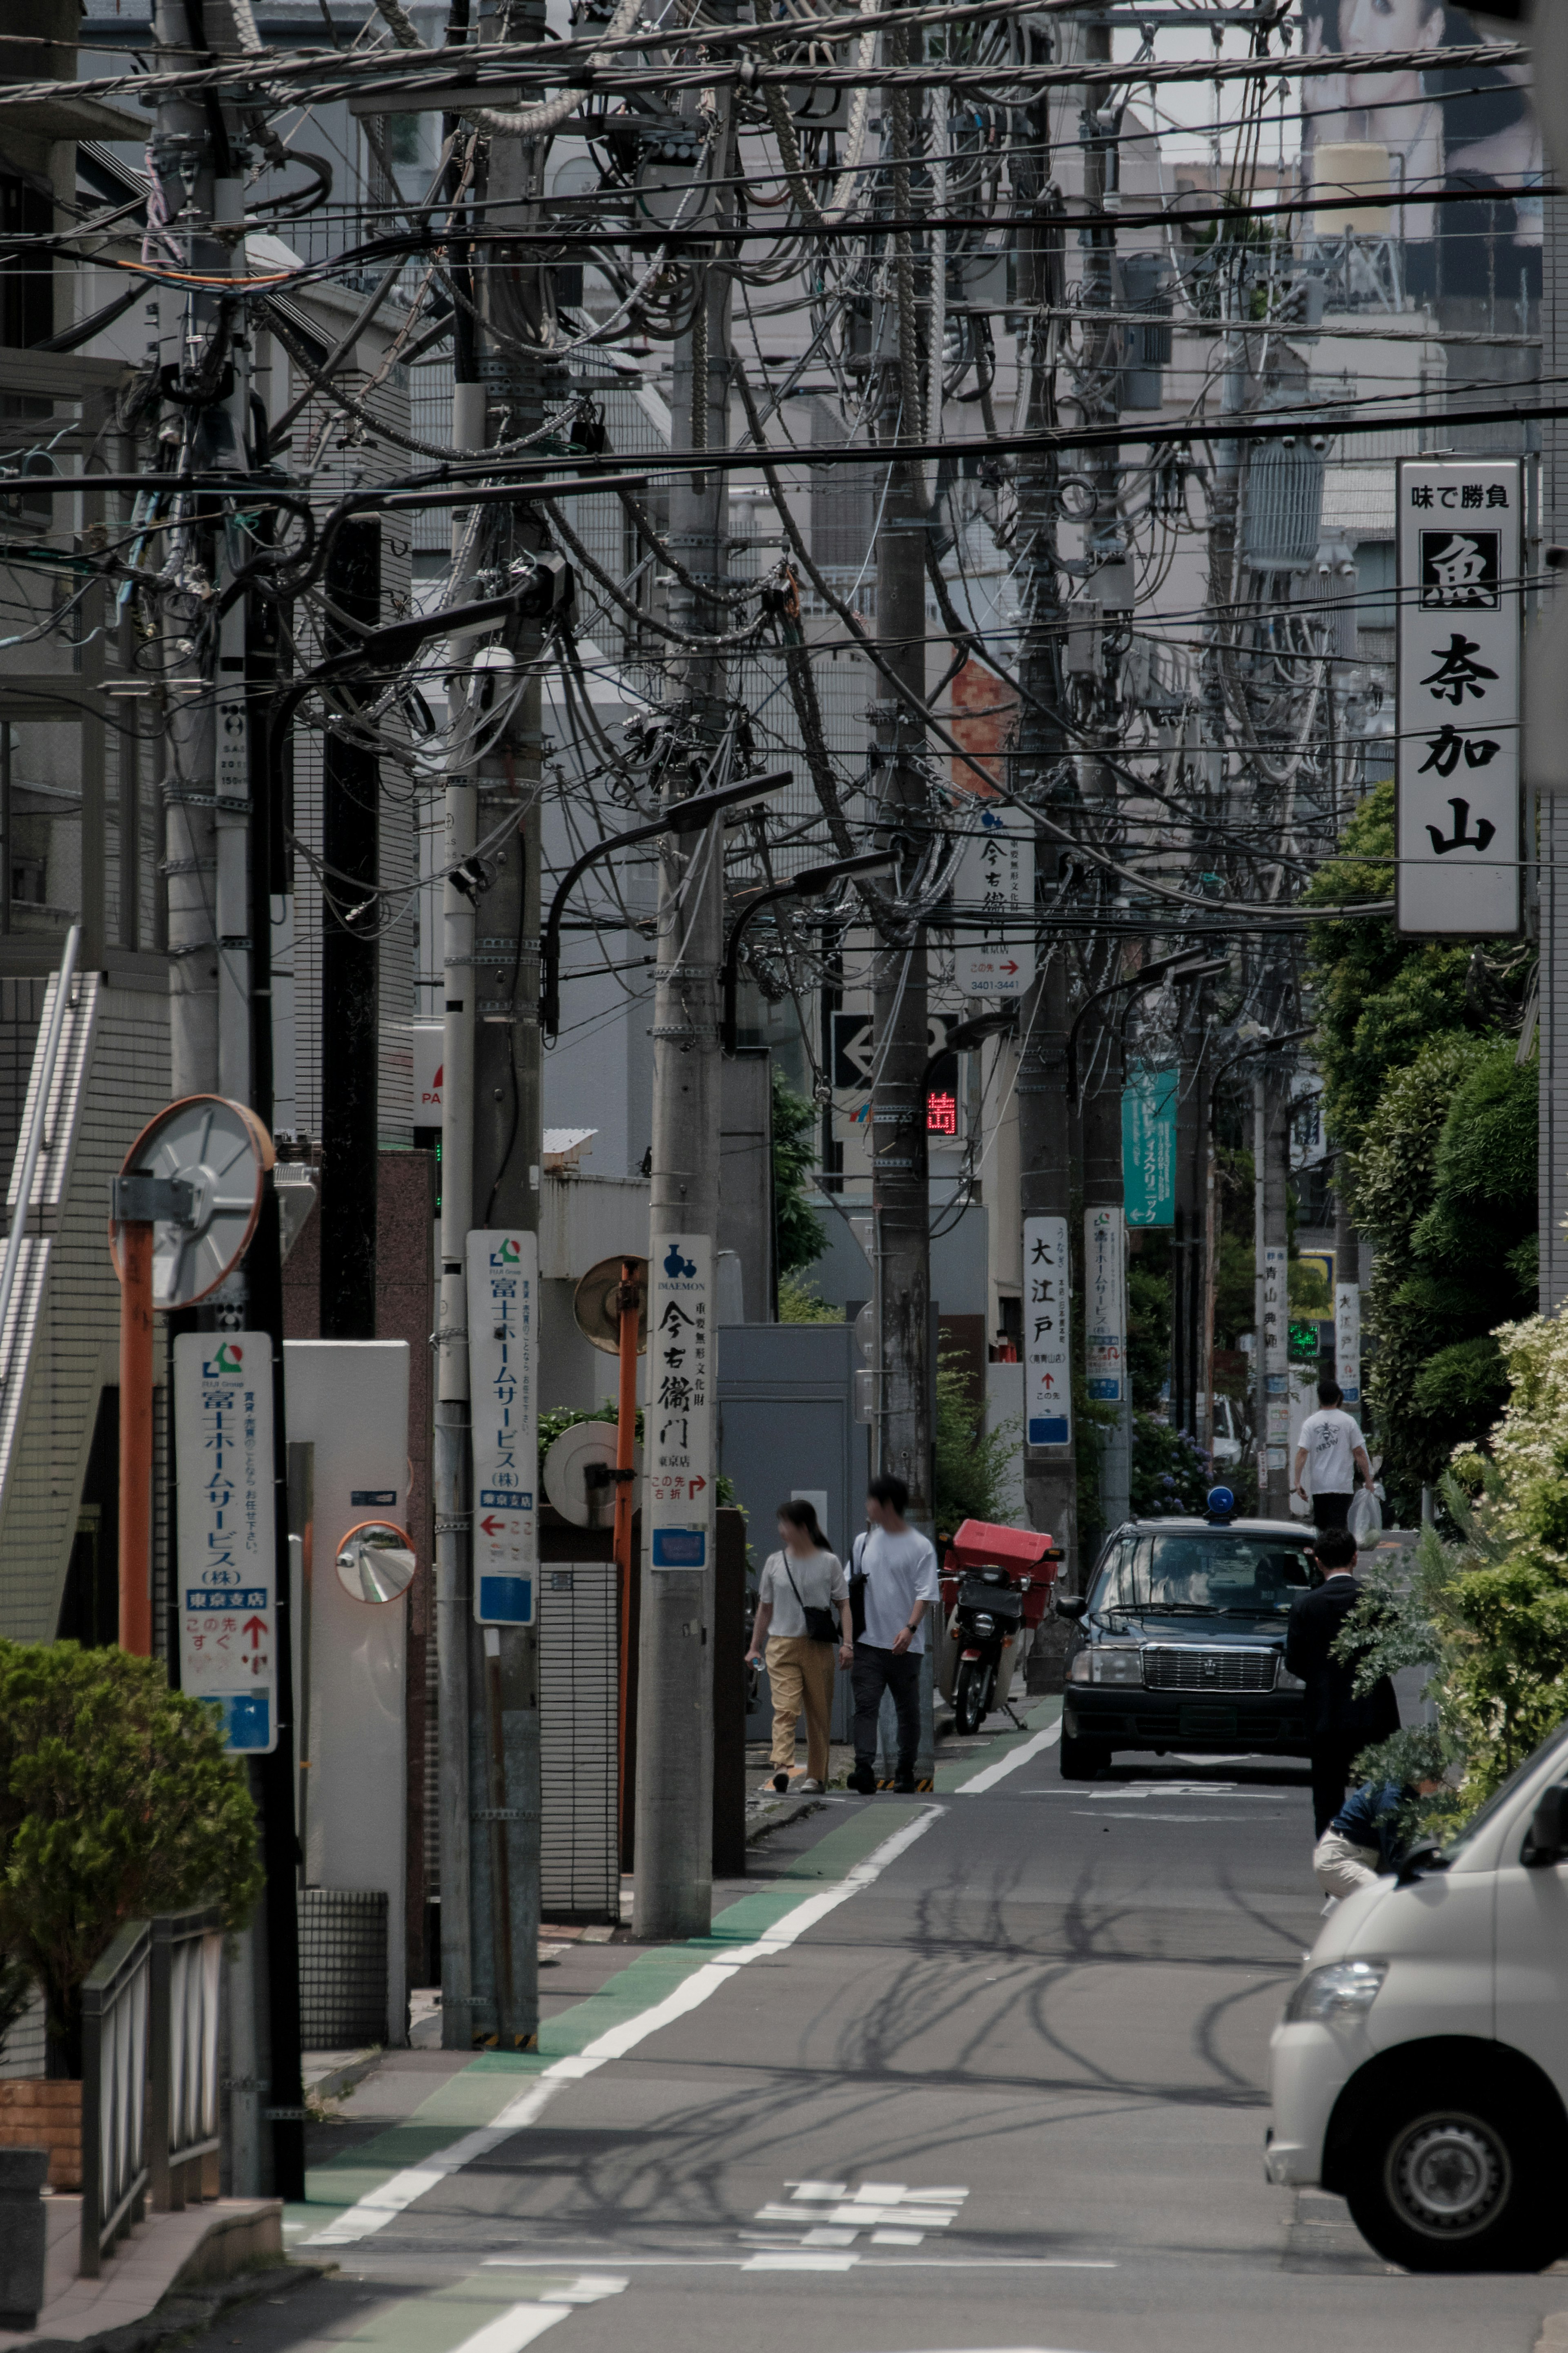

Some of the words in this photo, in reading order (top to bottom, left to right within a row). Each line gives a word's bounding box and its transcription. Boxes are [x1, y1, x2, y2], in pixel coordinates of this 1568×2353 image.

[1411, 484, 1510, 510] 味で勝負
[1425, 534, 1496, 607] 魚
[1418, 633, 1501, 855] 奈加山
[971, 963, 994, 973] この先
[971, 981, 1019, 990] 3401-3441
[658, 1282, 705, 1291] IMAEMON
[1031, 1238, 1055, 1343] 大江戸
[694, 1303, 705, 1406] 重要無形文化財
[659, 1455, 690, 1468] 東京店
[652, 1476, 685, 1488] この先
[655, 1488, 681, 1500] 右折
[189, 1592, 265, 1608] 東京支店
[187, 1617, 237, 1633] この先
[192, 1635, 230, 1650] すぐ
